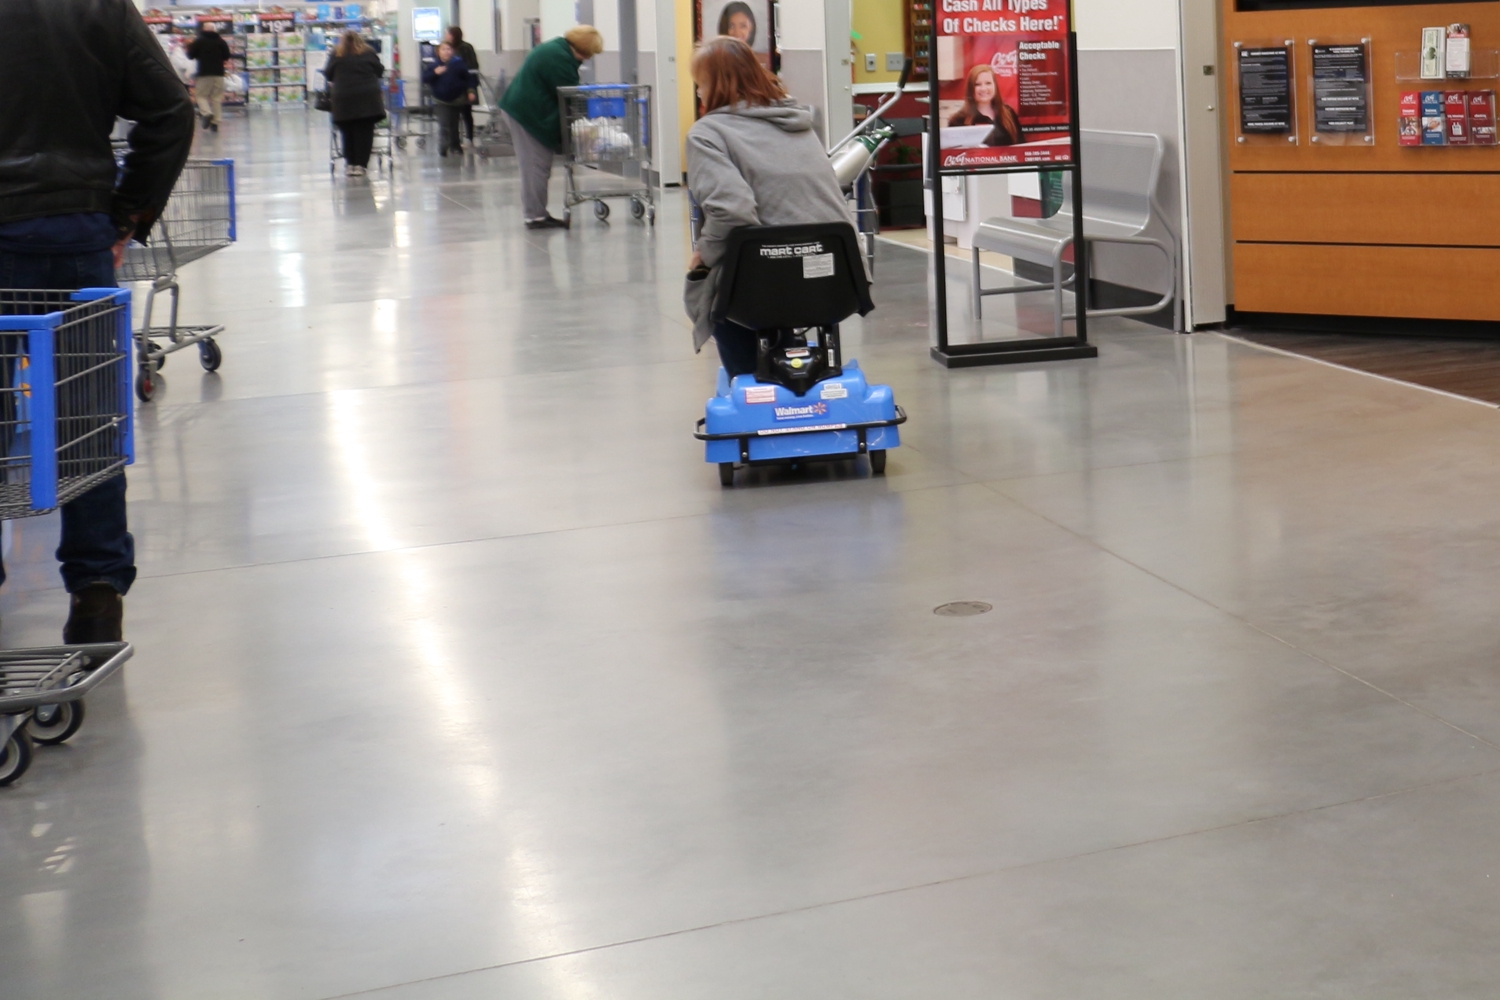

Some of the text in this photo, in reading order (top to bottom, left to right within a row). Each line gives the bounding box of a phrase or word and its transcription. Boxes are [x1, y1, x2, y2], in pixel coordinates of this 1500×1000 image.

[943, 17, 960, 34] Of
[963, 17, 1017, 33] Checks
[1019, 41, 1060, 51] Acceptable
[1019, 51, 1046, 60] Checks
[965, 155, 999, 164] NATIONAL
[1000, 154, 1018, 162] BANK
[774, 405, 814, 417] Walmart
